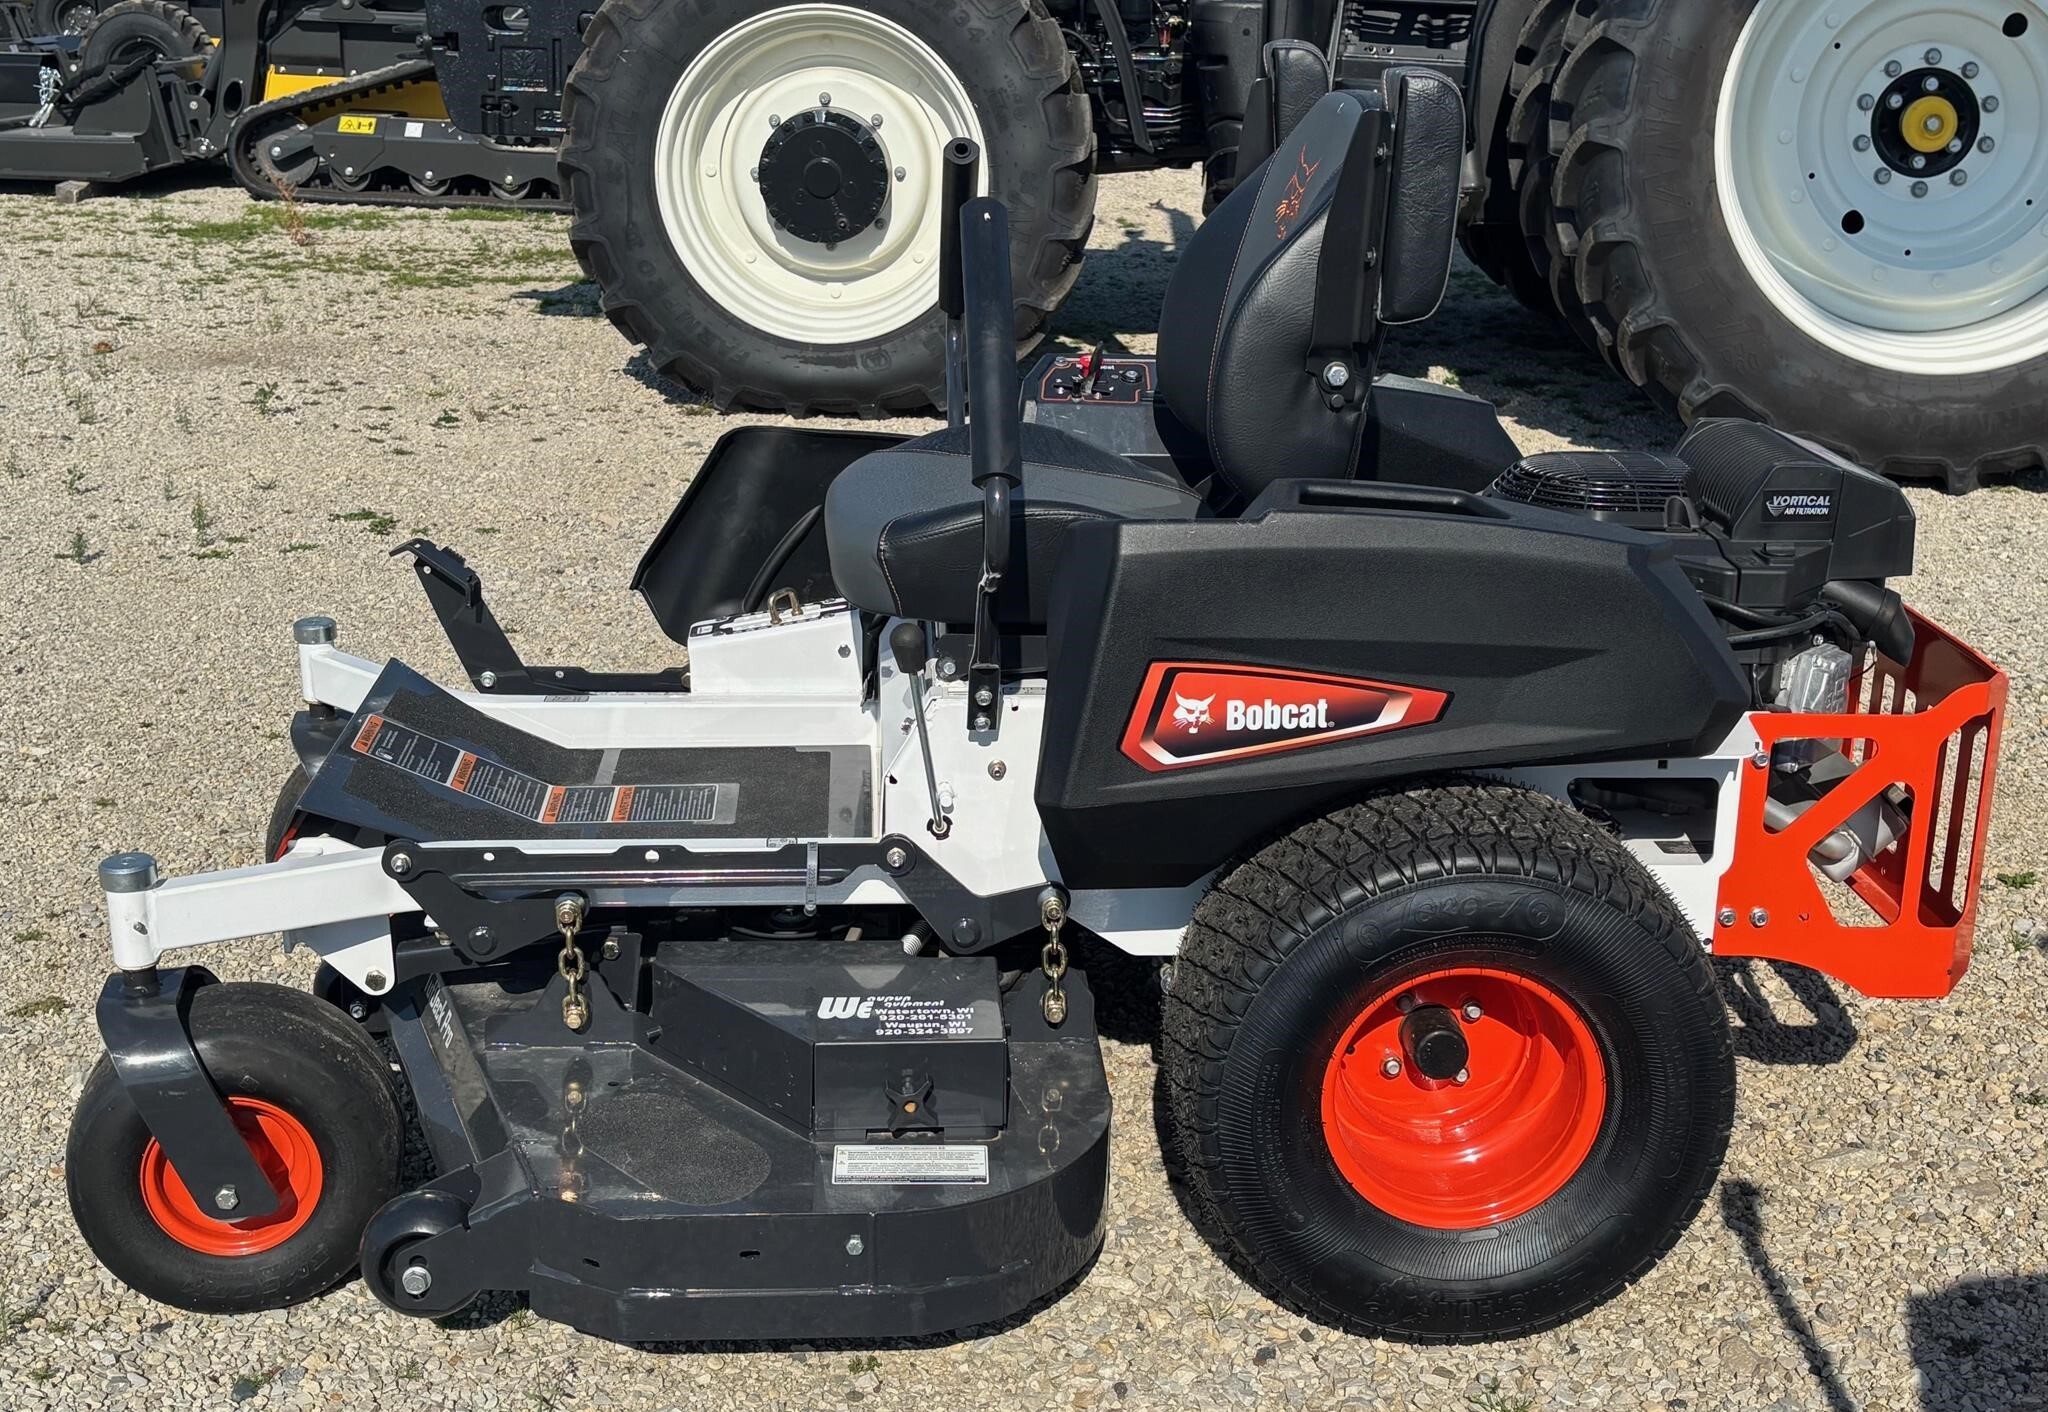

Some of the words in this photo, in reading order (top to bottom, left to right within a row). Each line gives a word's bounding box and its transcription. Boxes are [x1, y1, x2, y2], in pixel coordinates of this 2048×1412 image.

[1772, 495, 1831, 506] VORTICAL
[1783, 507, 1796, 515] AIR
[1795, 507, 1829, 515] FILTRATION
[1226, 698, 1329, 731] Bobcat
[440, 1009, 454, 1049] Pro
[885, 1021, 945, 1029] Waupun,
[875, 1027, 974, 1036] 920-324-3597
